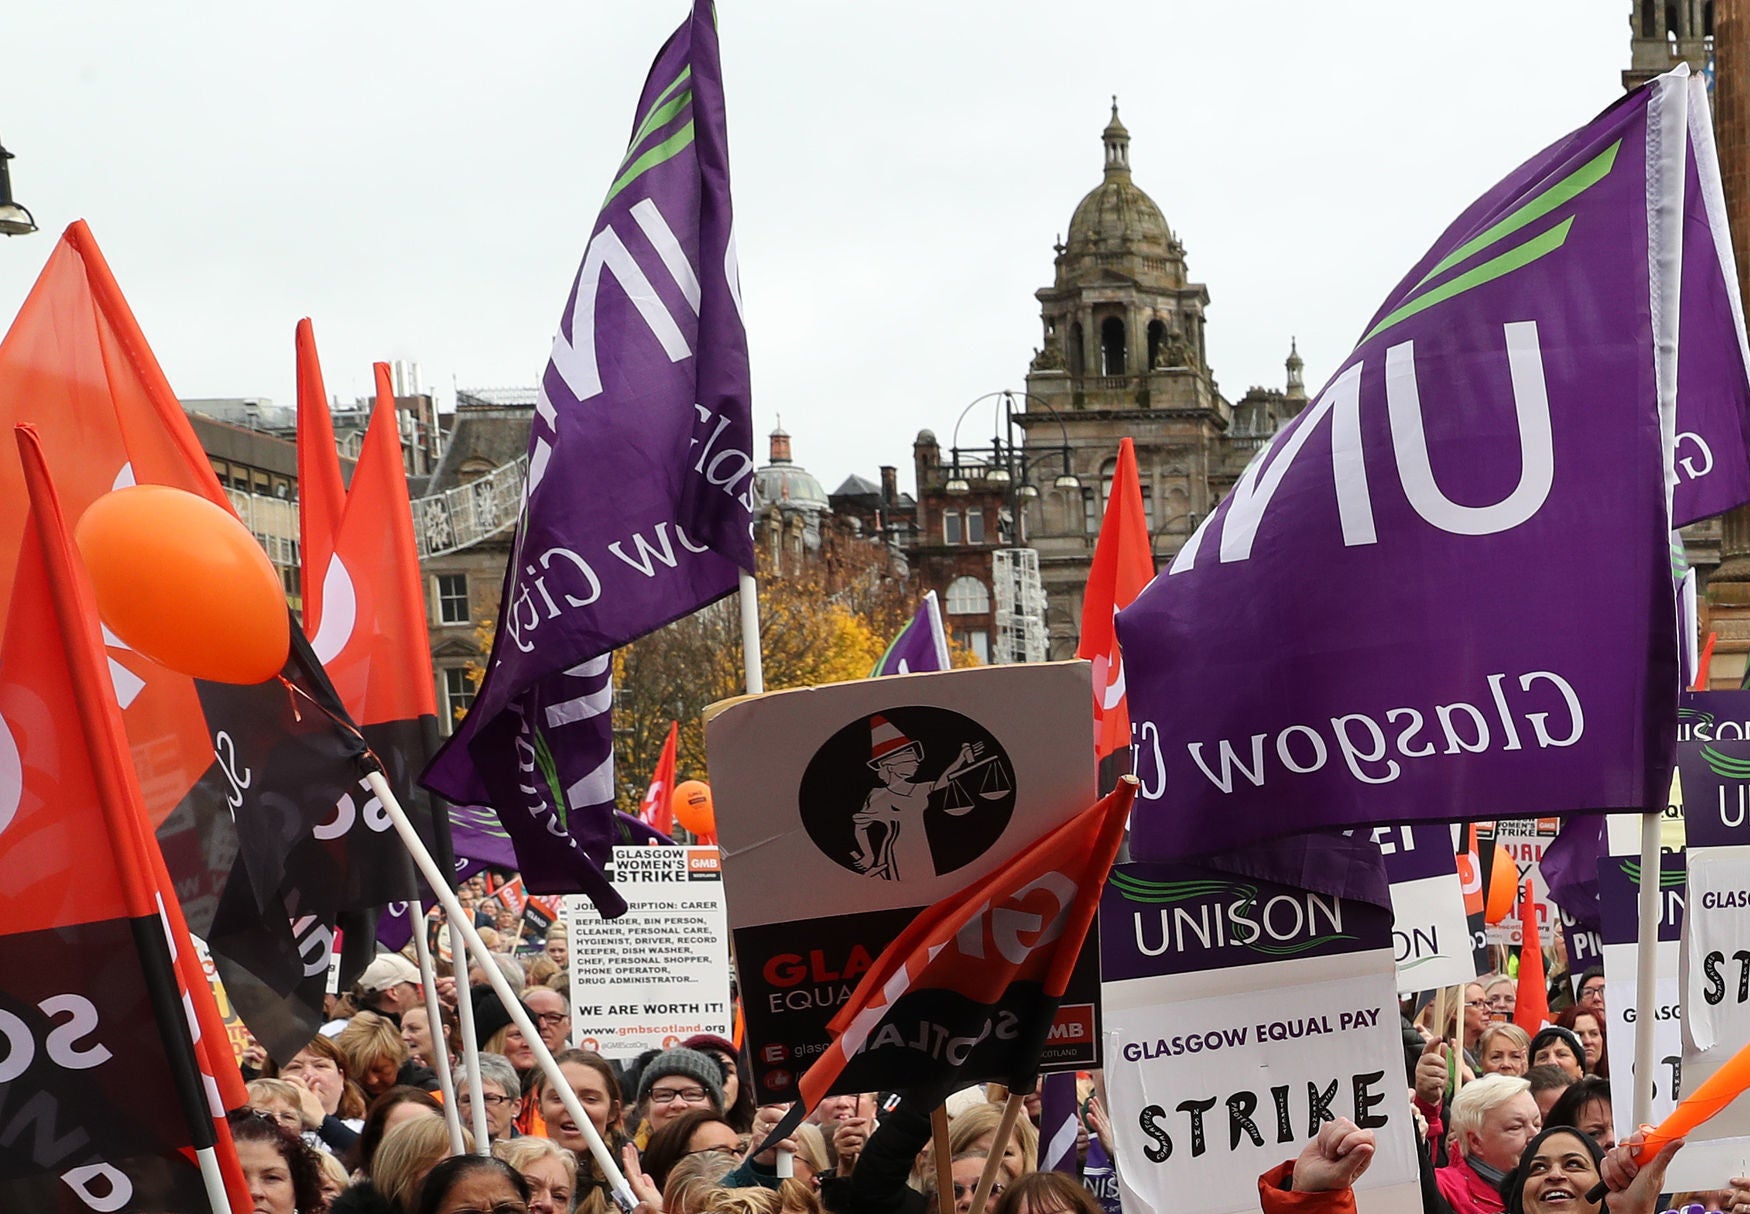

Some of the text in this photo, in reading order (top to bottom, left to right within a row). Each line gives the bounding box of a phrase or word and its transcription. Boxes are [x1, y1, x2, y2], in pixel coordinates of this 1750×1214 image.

[616, 850, 684, 859] GLASGOW
[616, 861, 686, 870] WOMEN'S
[690, 859, 718, 868] GMB
[616, 871, 686, 882] STRIKE
[576, 918, 641, 926] BEFRIENDER,
[664, 918, 707, 926] PERSON,
[1134, 893, 1344, 957] UNISON
[576, 928, 626, 936] CLEANER,
[683, 927, 713, 935] CARE,
[576, 938, 632, 946] HYGIENIST,
[635, 937, 674, 945] DRIVER,
[577, 947, 693, 956] KEEPER, DISH WASHER,
[577, 956, 713, 966] CHEF, PERSONAL SHOPPER,
[578, 967, 671, 975] PHONE OPERATOR,
[770, 983, 851, 1013] EQUA
[579, 1003, 724, 1016] WE ARE WORTH IT!
[582, 1023, 726, 1036] www.gmbscotland.org
[1048, 1022, 1085, 1040] MB
[1123, 1008, 1381, 1062] GLASGOW EQUAL PAY
[1139, 1070, 1388, 1163] STRIKE
